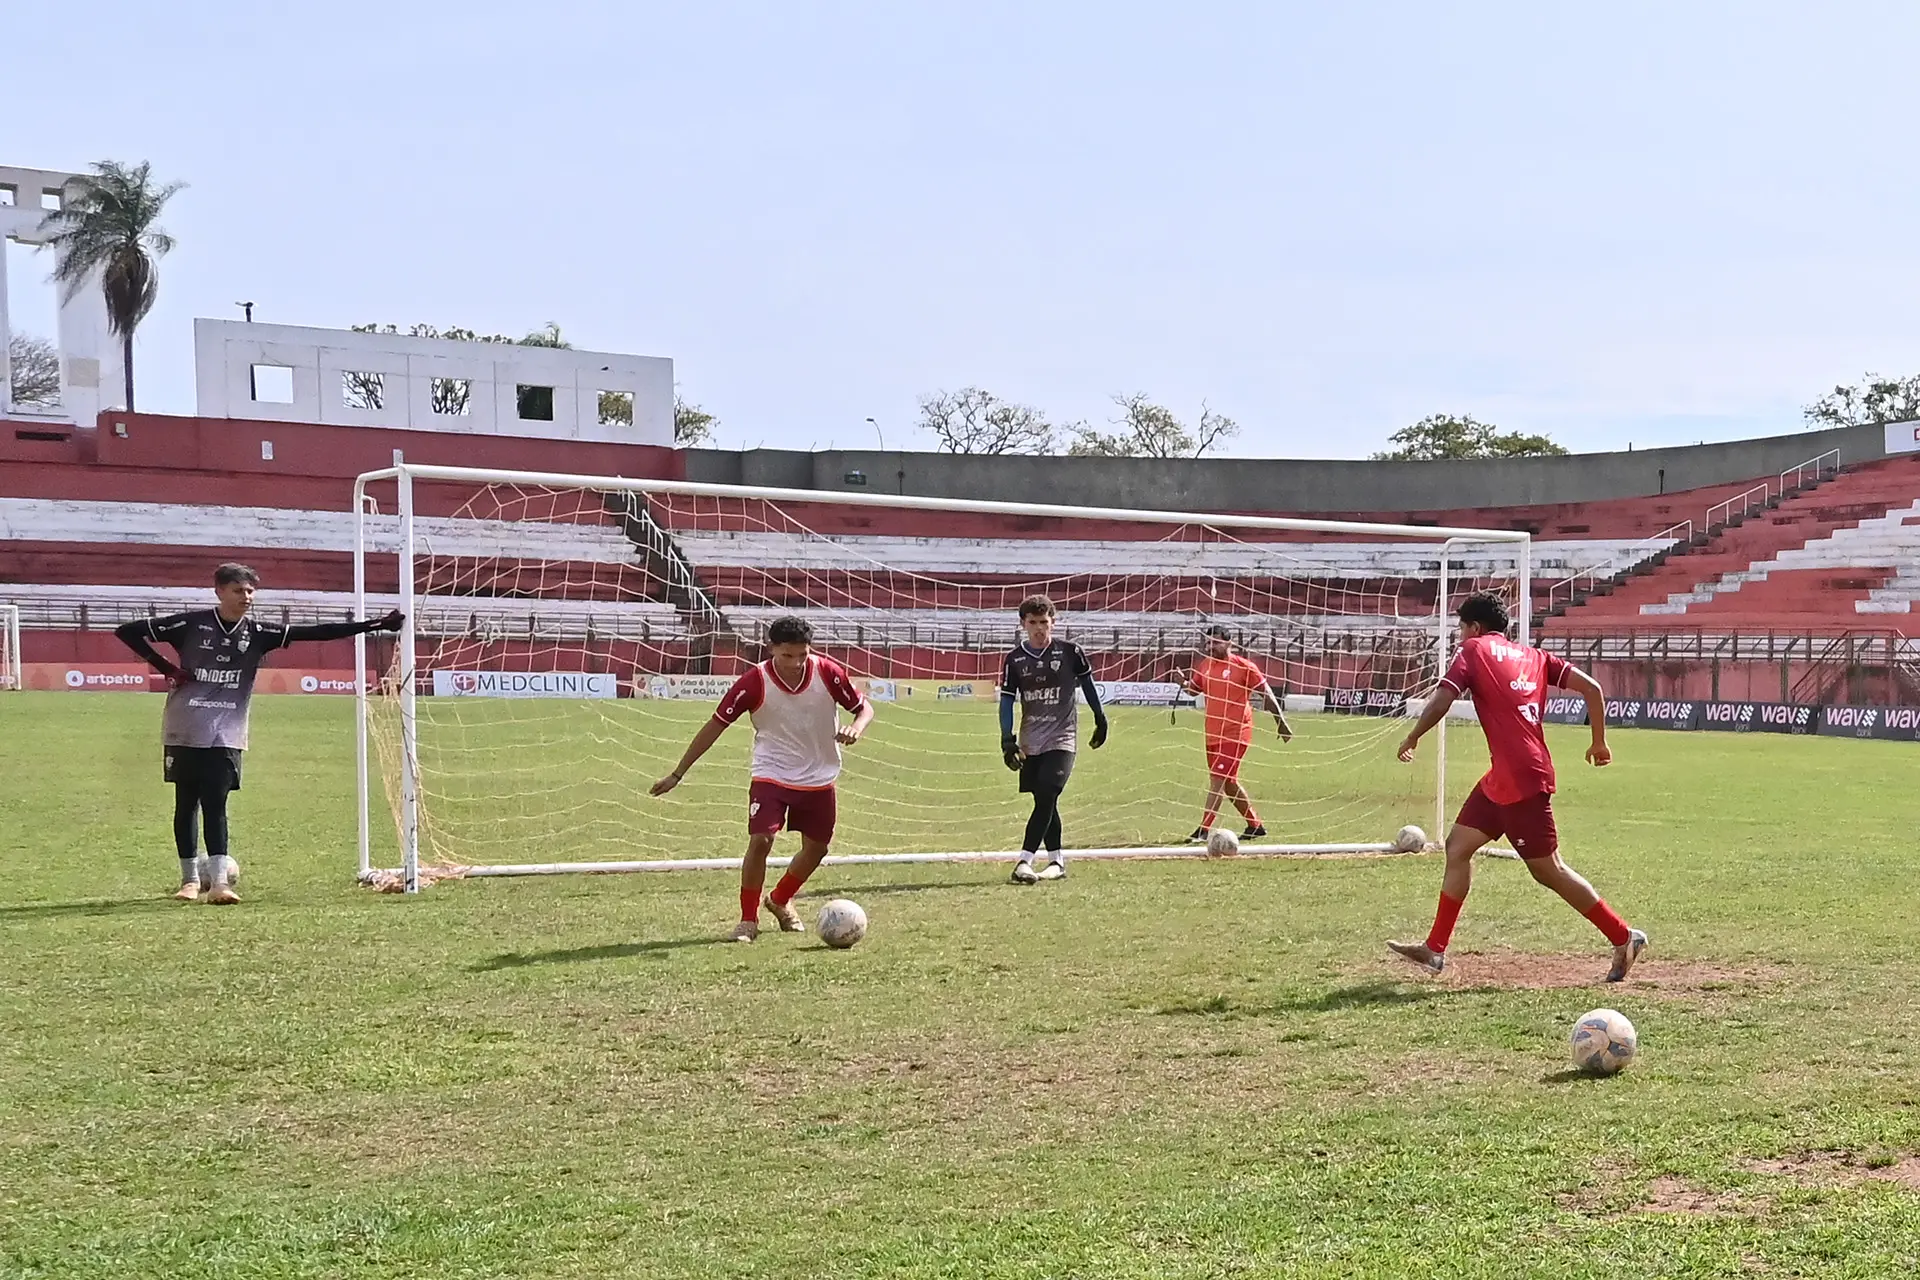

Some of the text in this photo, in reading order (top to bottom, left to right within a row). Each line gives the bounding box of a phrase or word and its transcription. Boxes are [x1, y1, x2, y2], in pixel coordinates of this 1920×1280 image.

[86, 674, 143, 685] artpetro
[478, 674, 600, 693] MEDCLINIC
[320, 680, 357, 691] artpe
[1856, 727, 1873, 738] bank
